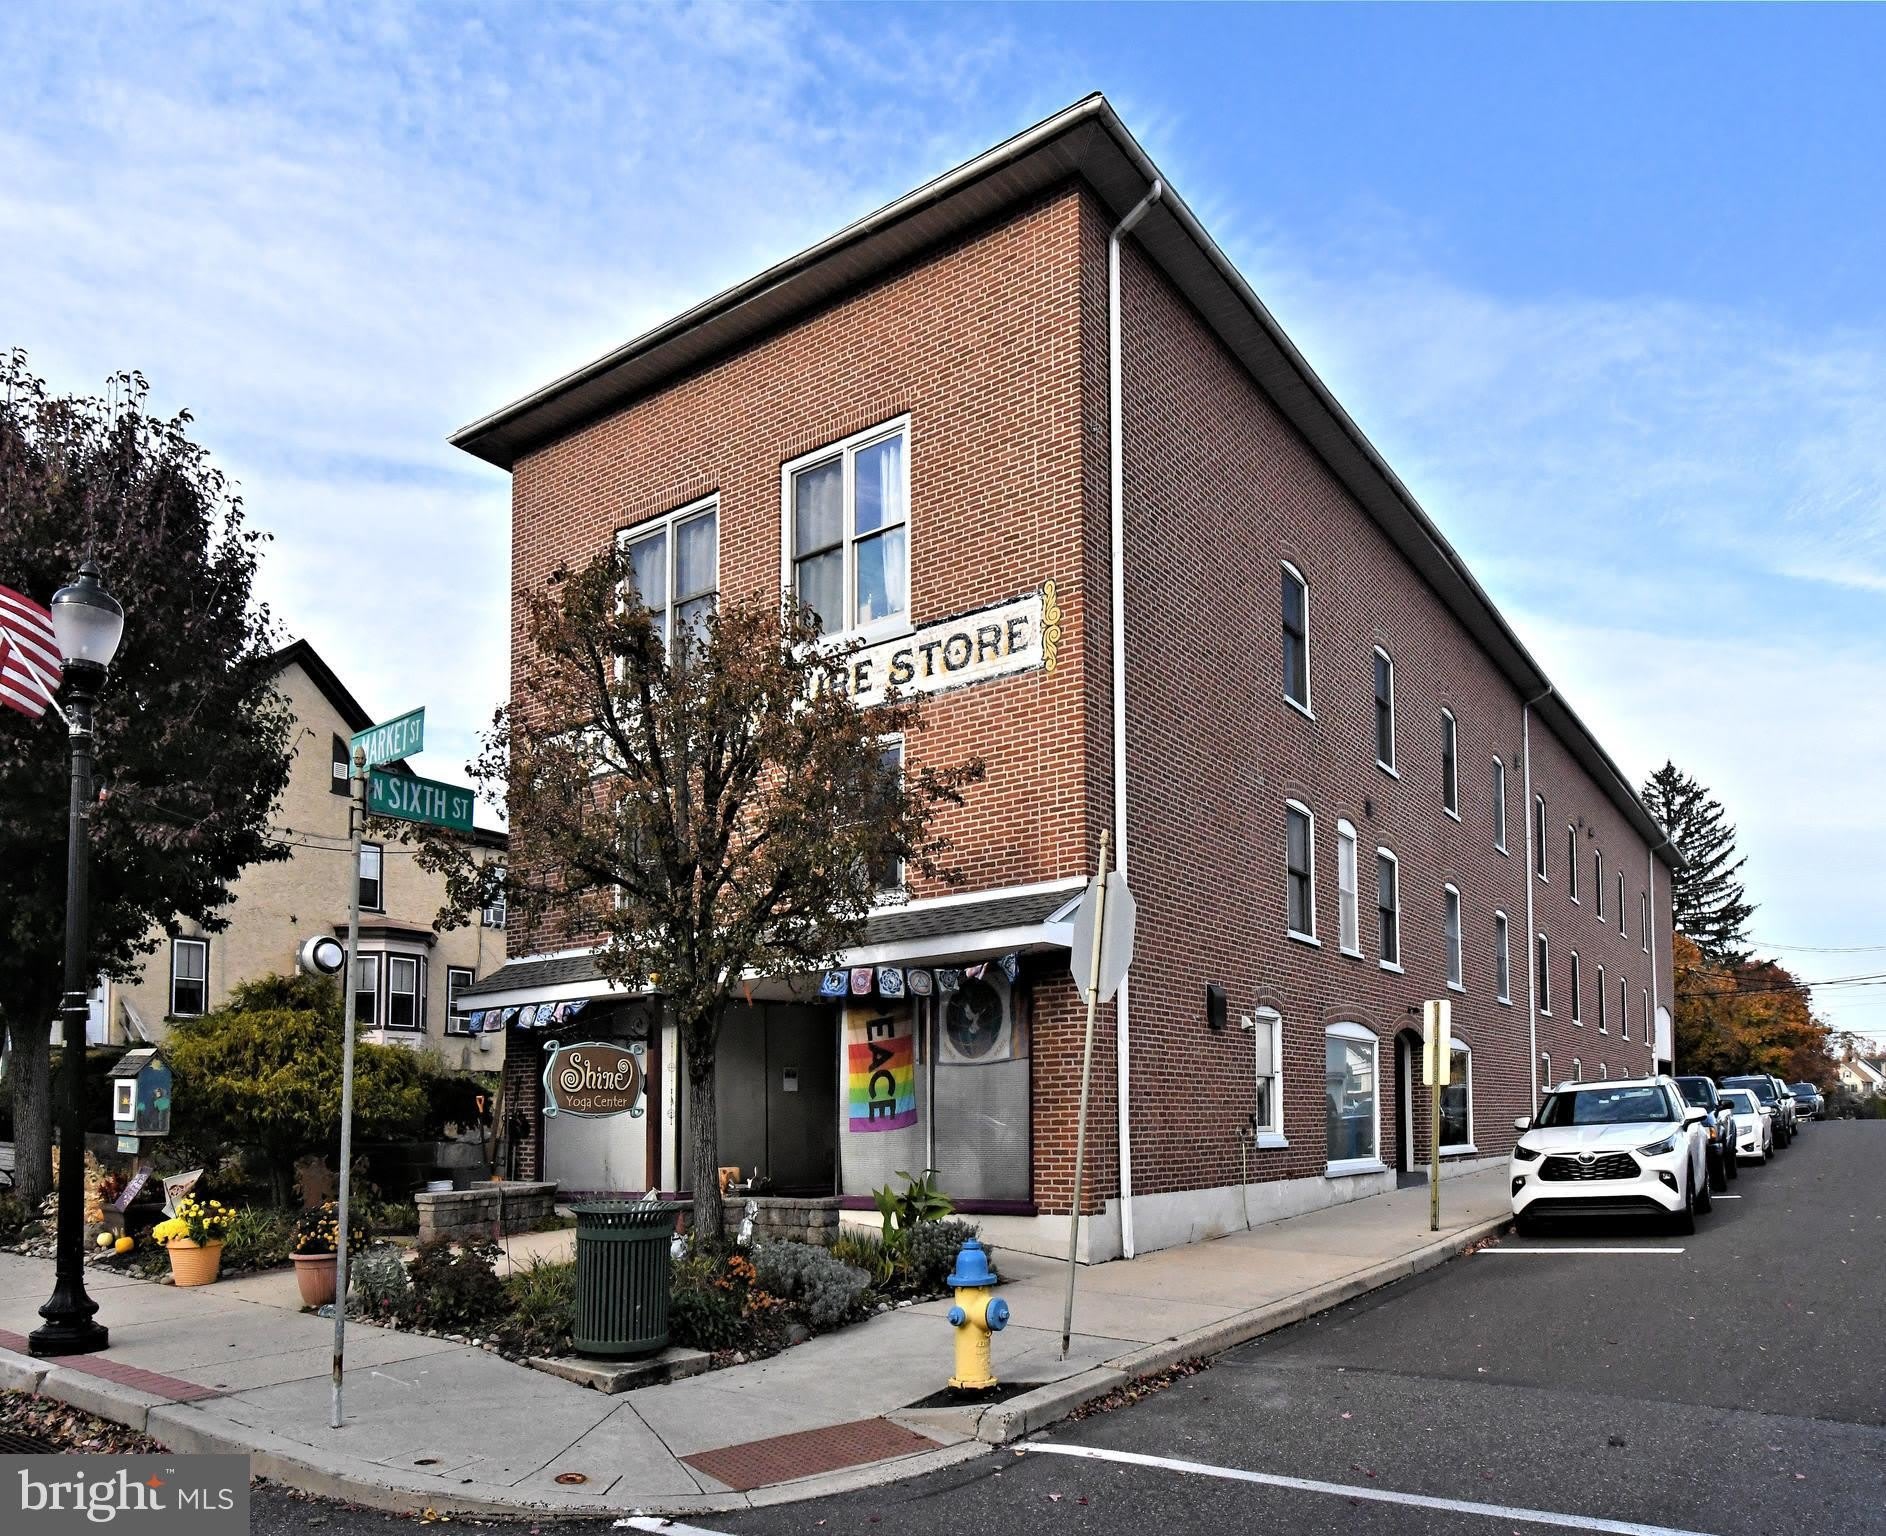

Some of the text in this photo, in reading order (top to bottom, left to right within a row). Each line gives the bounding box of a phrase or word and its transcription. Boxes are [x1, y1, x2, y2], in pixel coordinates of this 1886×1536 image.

[889, 615, 1029, 685] STORE
[362, 719, 409, 766] MARKET
[410, 719, 421, 744] ST
[373, 777, 469, 820] N SIXTH ST
[560, 1052, 633, 1093] Shine
[866, 1006, 897, 1122] EACE
[566, 1095, 628, 1111] Yoga Center
